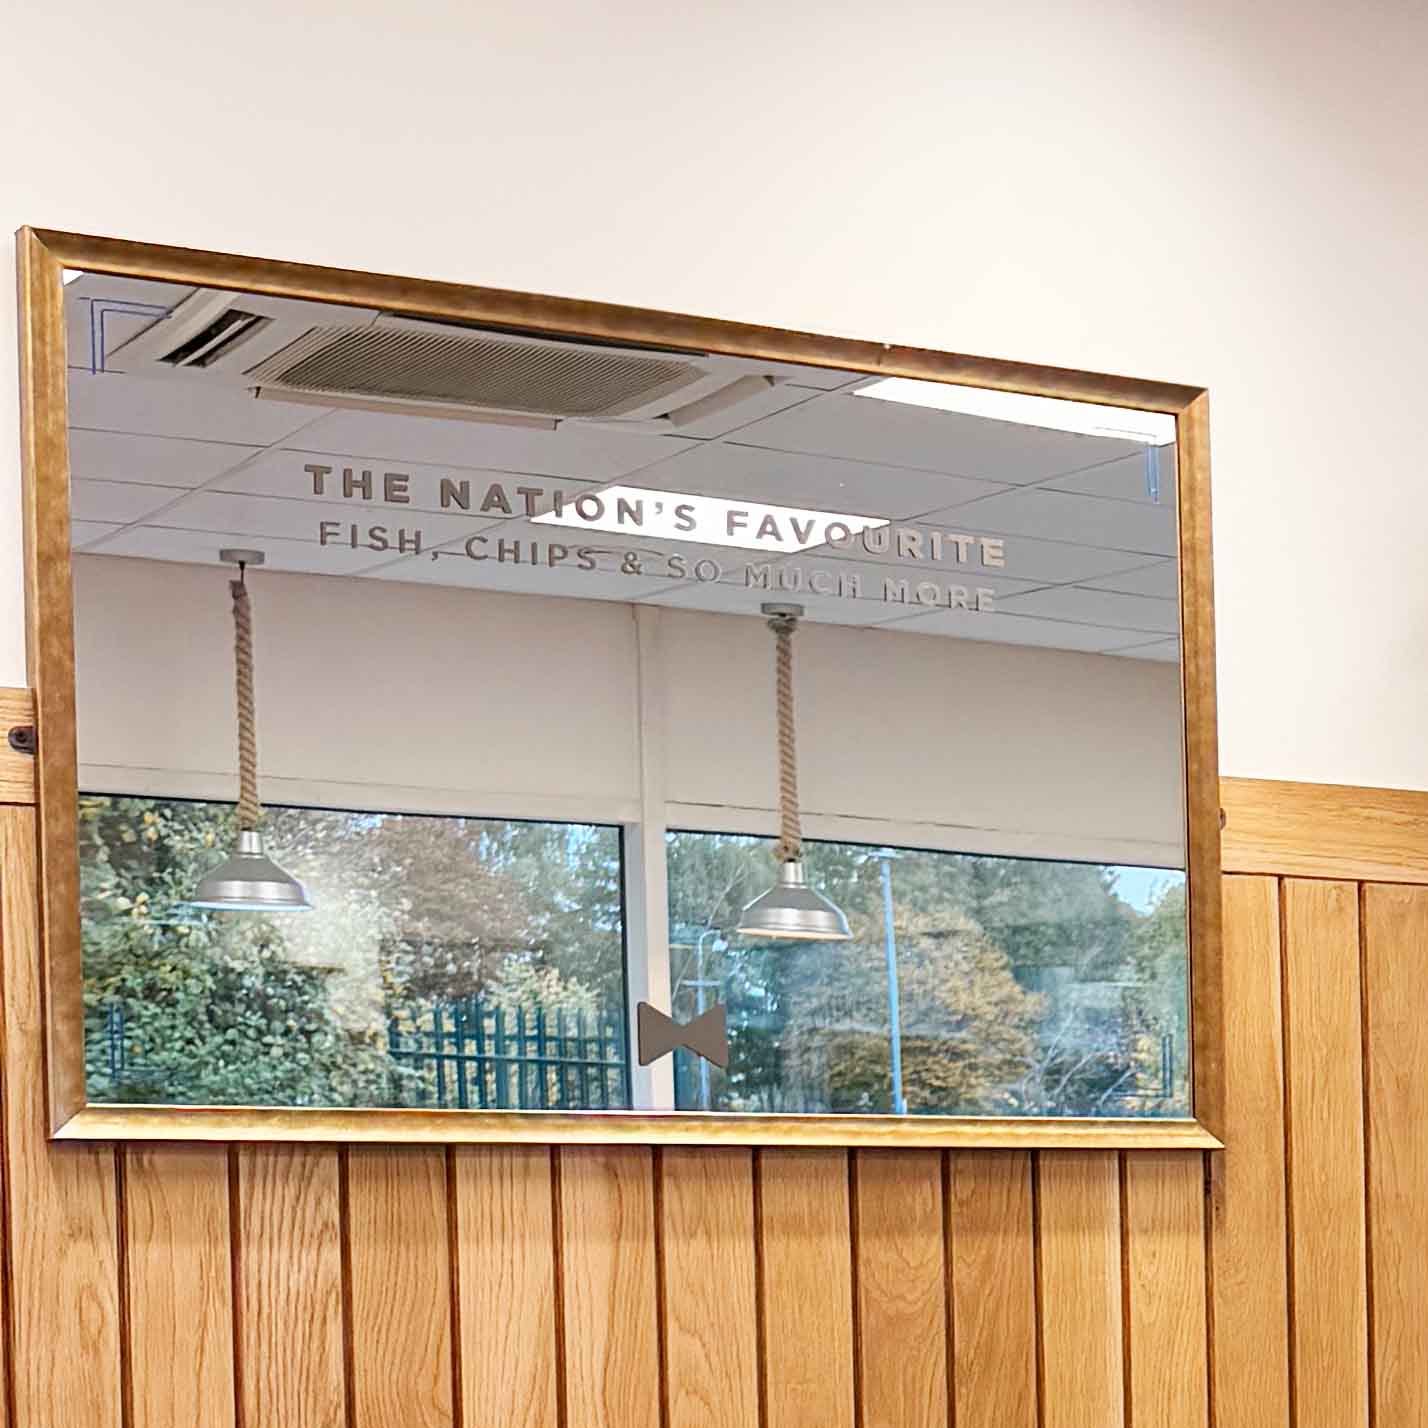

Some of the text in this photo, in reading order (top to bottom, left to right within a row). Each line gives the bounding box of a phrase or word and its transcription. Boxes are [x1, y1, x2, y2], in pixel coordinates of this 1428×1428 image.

[304, 463, 1007, 568] THE NATION'S FAVOURITE
[319, 521, 997, 613] FISH, CHIPS & SO MUCH MORE
